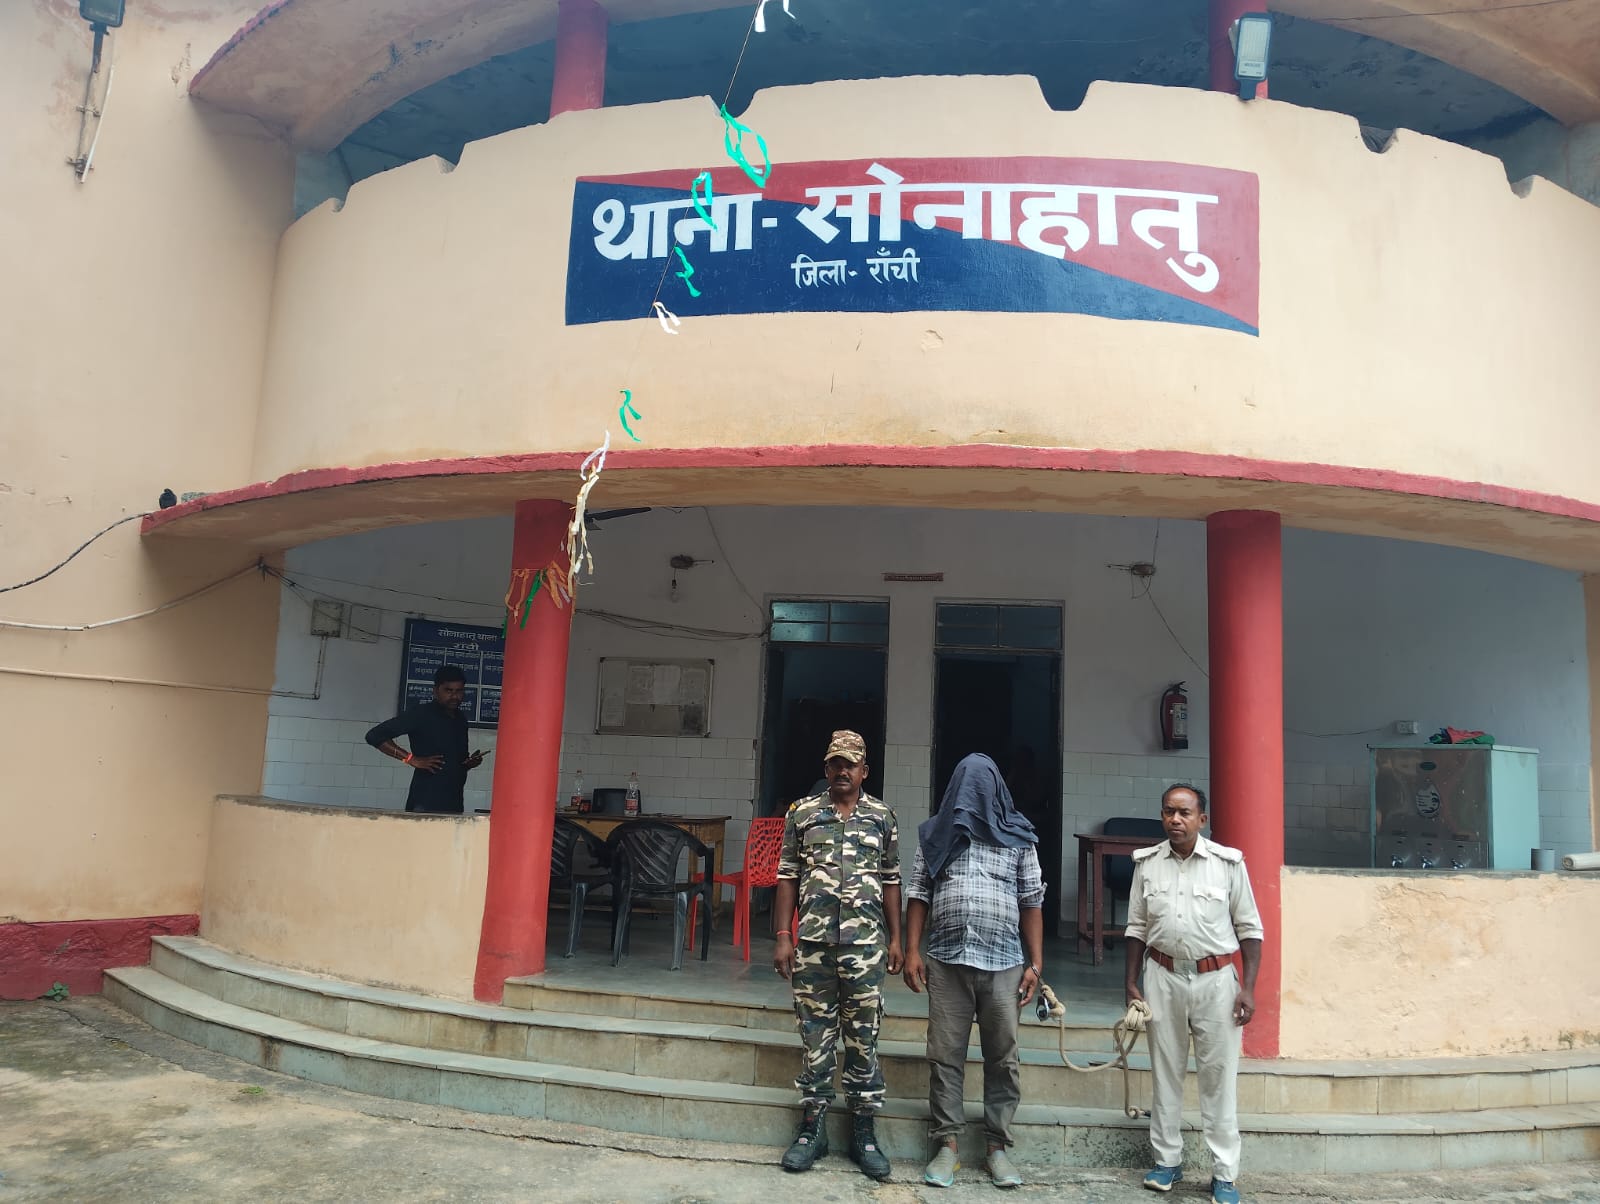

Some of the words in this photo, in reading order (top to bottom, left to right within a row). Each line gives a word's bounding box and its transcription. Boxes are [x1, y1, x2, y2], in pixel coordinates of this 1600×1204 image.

[592, 193, 777, 261] थाना-
[796, 162, 1219, 293] सोनाहातु
[866, 246, 921, 284] राँची
